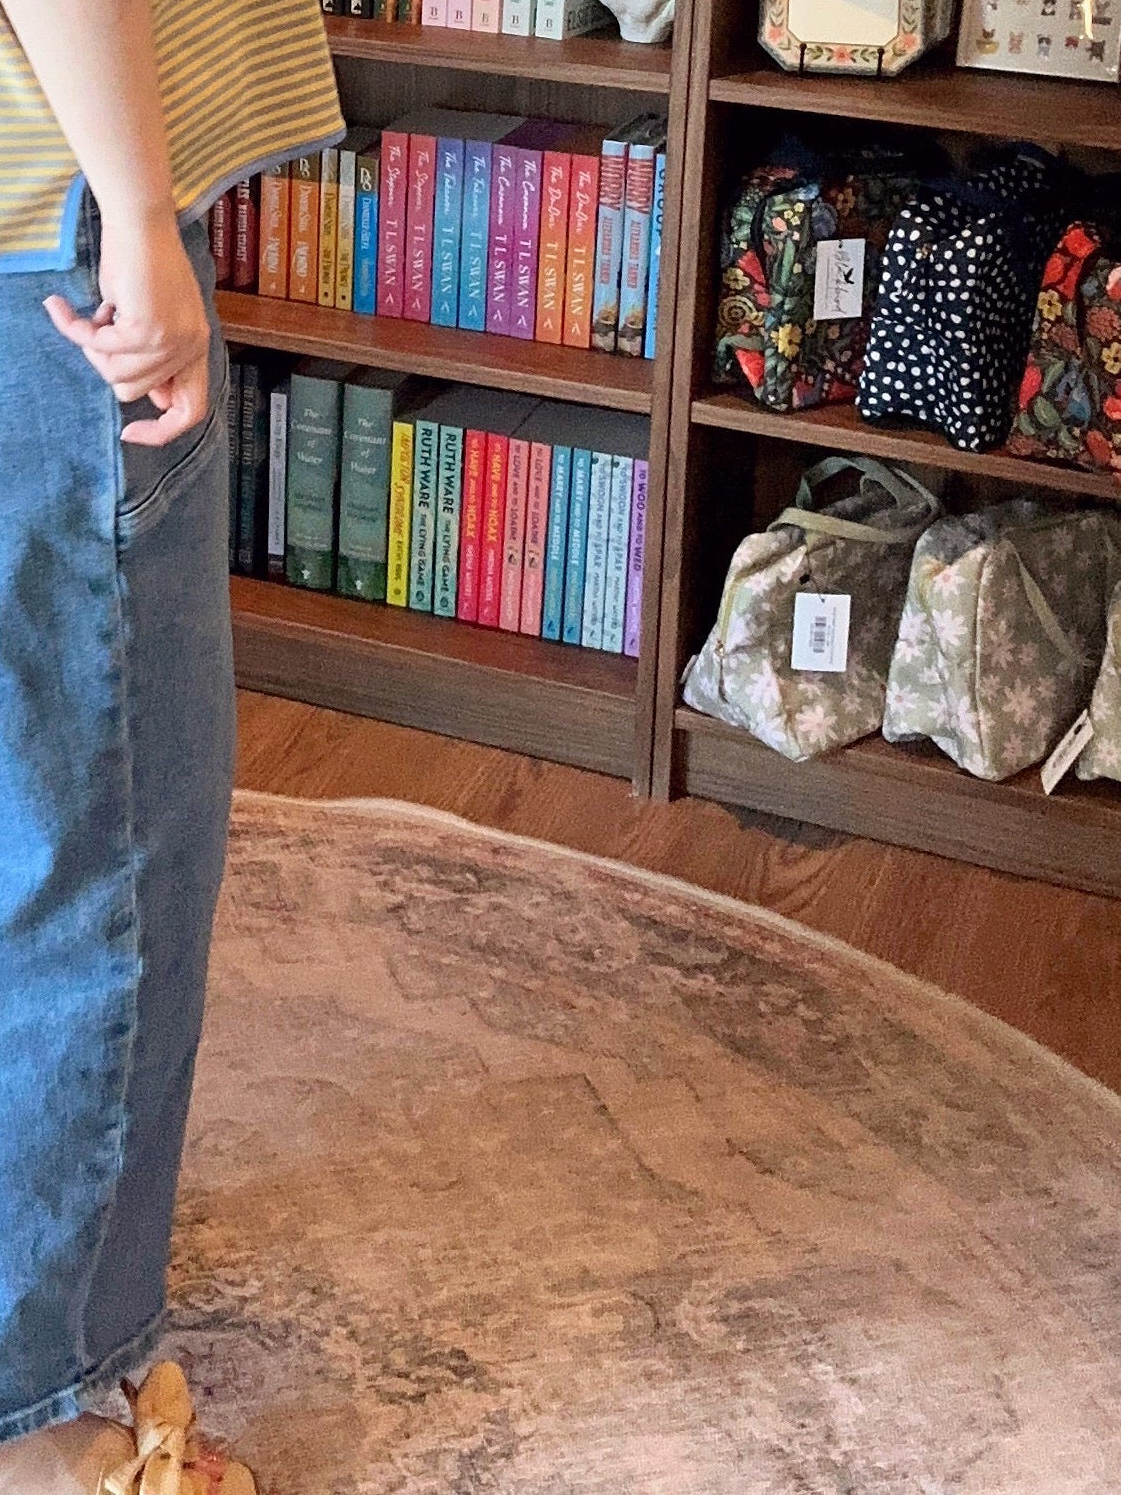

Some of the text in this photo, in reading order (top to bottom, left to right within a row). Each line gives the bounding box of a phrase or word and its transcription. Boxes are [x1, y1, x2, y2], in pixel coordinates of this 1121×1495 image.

[383, 242, 397, 285] SWAN
[411, 249, 426, 292] SWAN
[440, 251, 455, 294] SWAN
[491, 260, 506, 303] SWAN
[516, 265, 531, 308] SWAN
[542, 267, 558, 311] SWAN
[570, 272, 585, 316] SWAN
[468, 450, 479, 477] HAVE
[417, 428, 433, 558] RUTH WARE LYING
[441, 433, 457, 592] RUTH WARE LYING GAME
[486, 454, 501, 542] HAVE HOAX
[596, 477, 608, 512] SWOON
[633, 483, 646, 571] WOO WED
